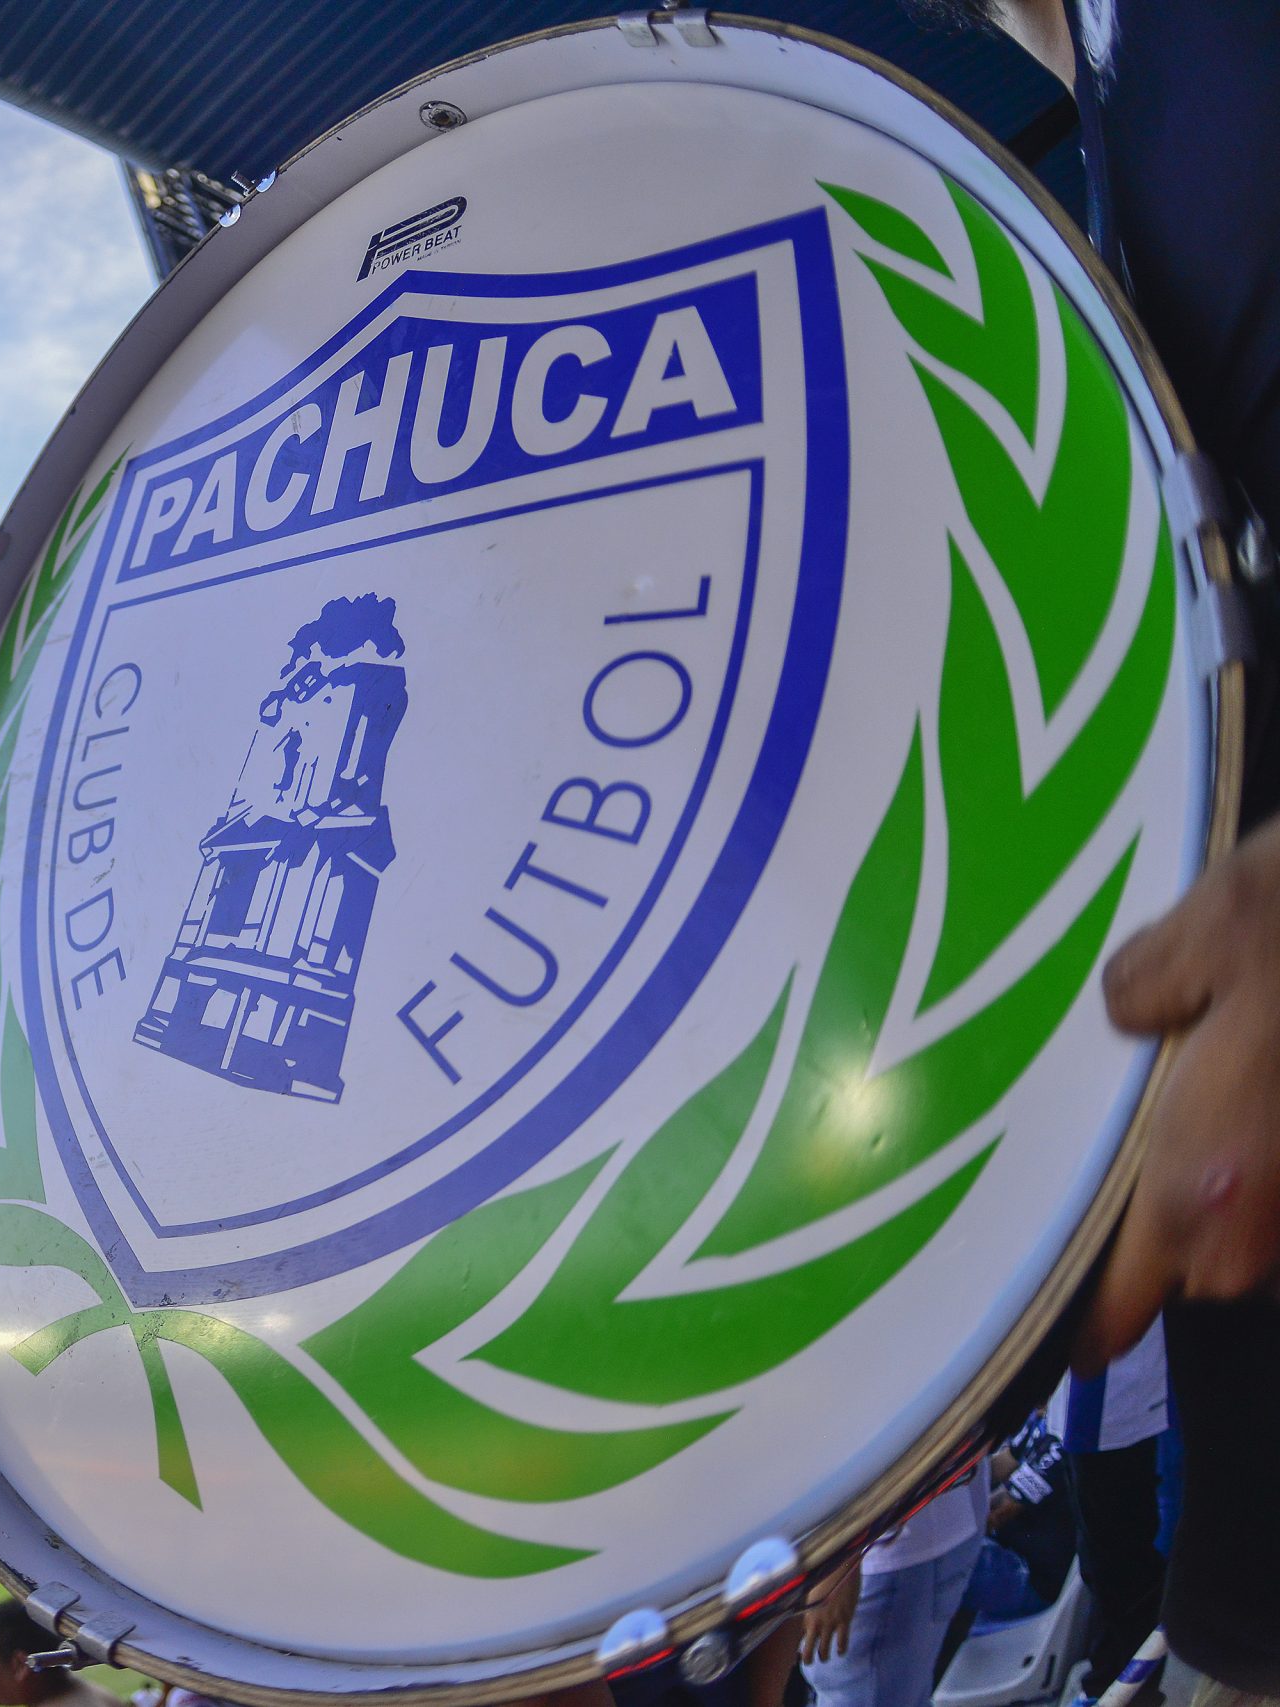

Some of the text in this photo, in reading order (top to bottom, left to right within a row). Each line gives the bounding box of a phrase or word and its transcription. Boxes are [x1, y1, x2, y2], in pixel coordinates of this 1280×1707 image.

[371, 243, 422, 275] POWER
[424, 225, 462, 251] BEAT
[129, 305, 738, 569] PACHUCA
[65, 662, 142, 1011] CLUB DE
[396, 575, 711, 1085] FUTBOL
